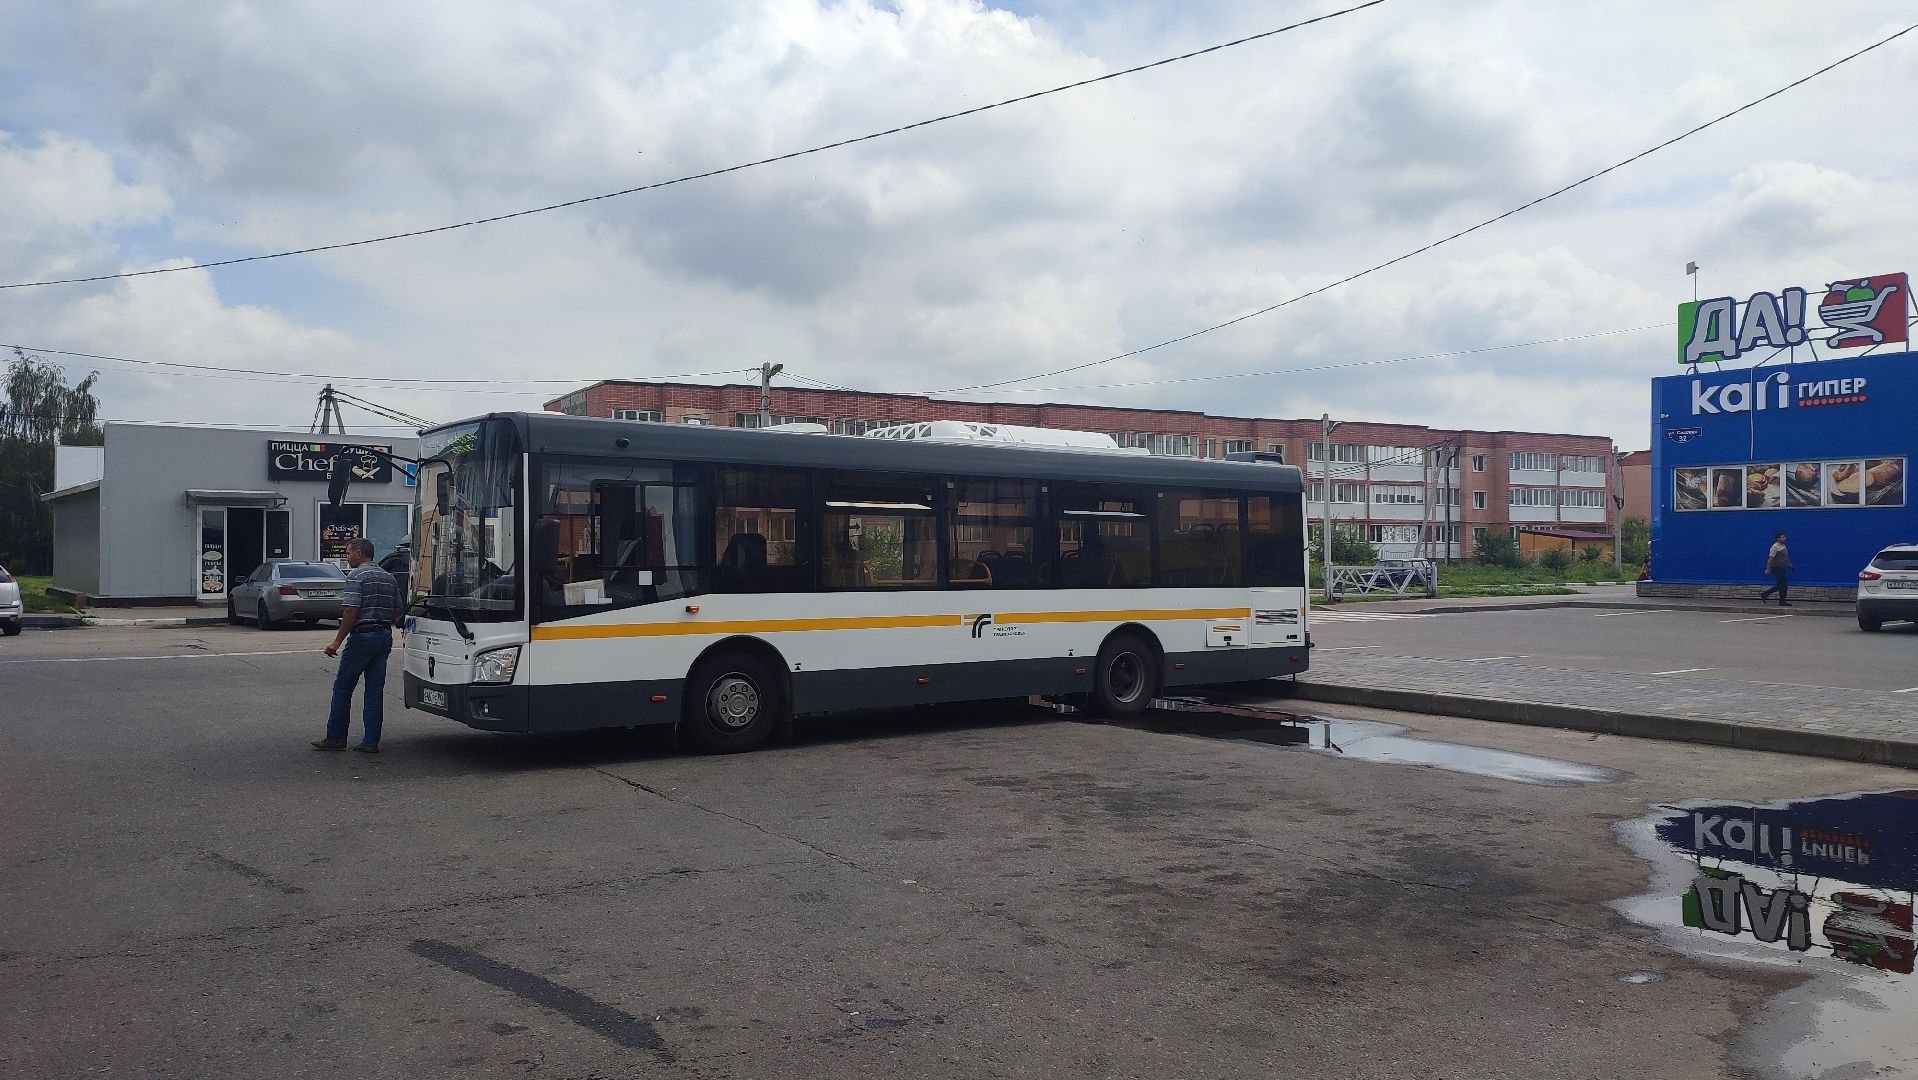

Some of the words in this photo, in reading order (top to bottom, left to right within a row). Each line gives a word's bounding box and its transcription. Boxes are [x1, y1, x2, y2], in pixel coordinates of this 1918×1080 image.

[1685, 287, 1807, 363] ДА!
[1691, 371, 1790, 416] kari
[1798, 377, 1868, 399] ГИПЕР
[271, 442, 309, 453] ПИЦЦА
[274, 452, 339, 472] Chef
